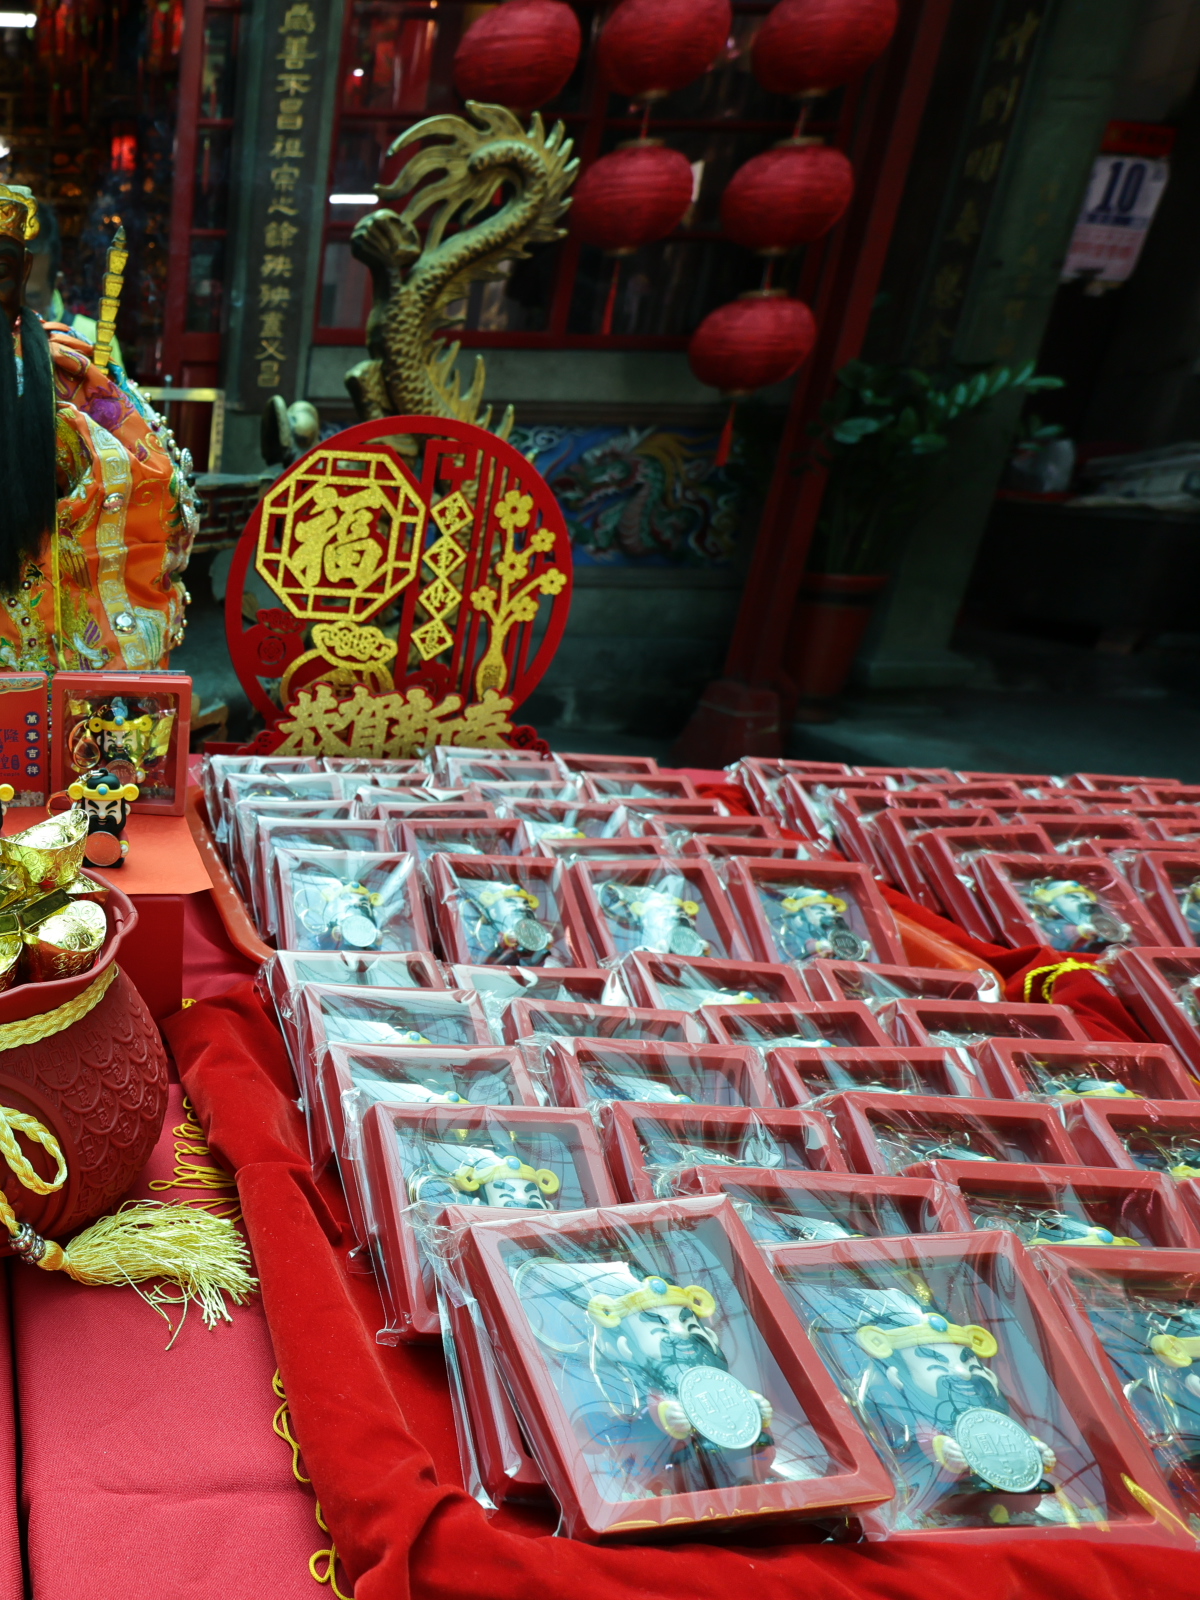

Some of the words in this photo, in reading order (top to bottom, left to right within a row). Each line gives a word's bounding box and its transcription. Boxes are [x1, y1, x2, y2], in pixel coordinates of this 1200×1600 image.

[1093, 160, 1148, 213] 10
[293, 486, 384, 590] 福
[25, 713, 40, 776] 萬事吉祥
[270, 683, 515, 759] 恭賀新春
